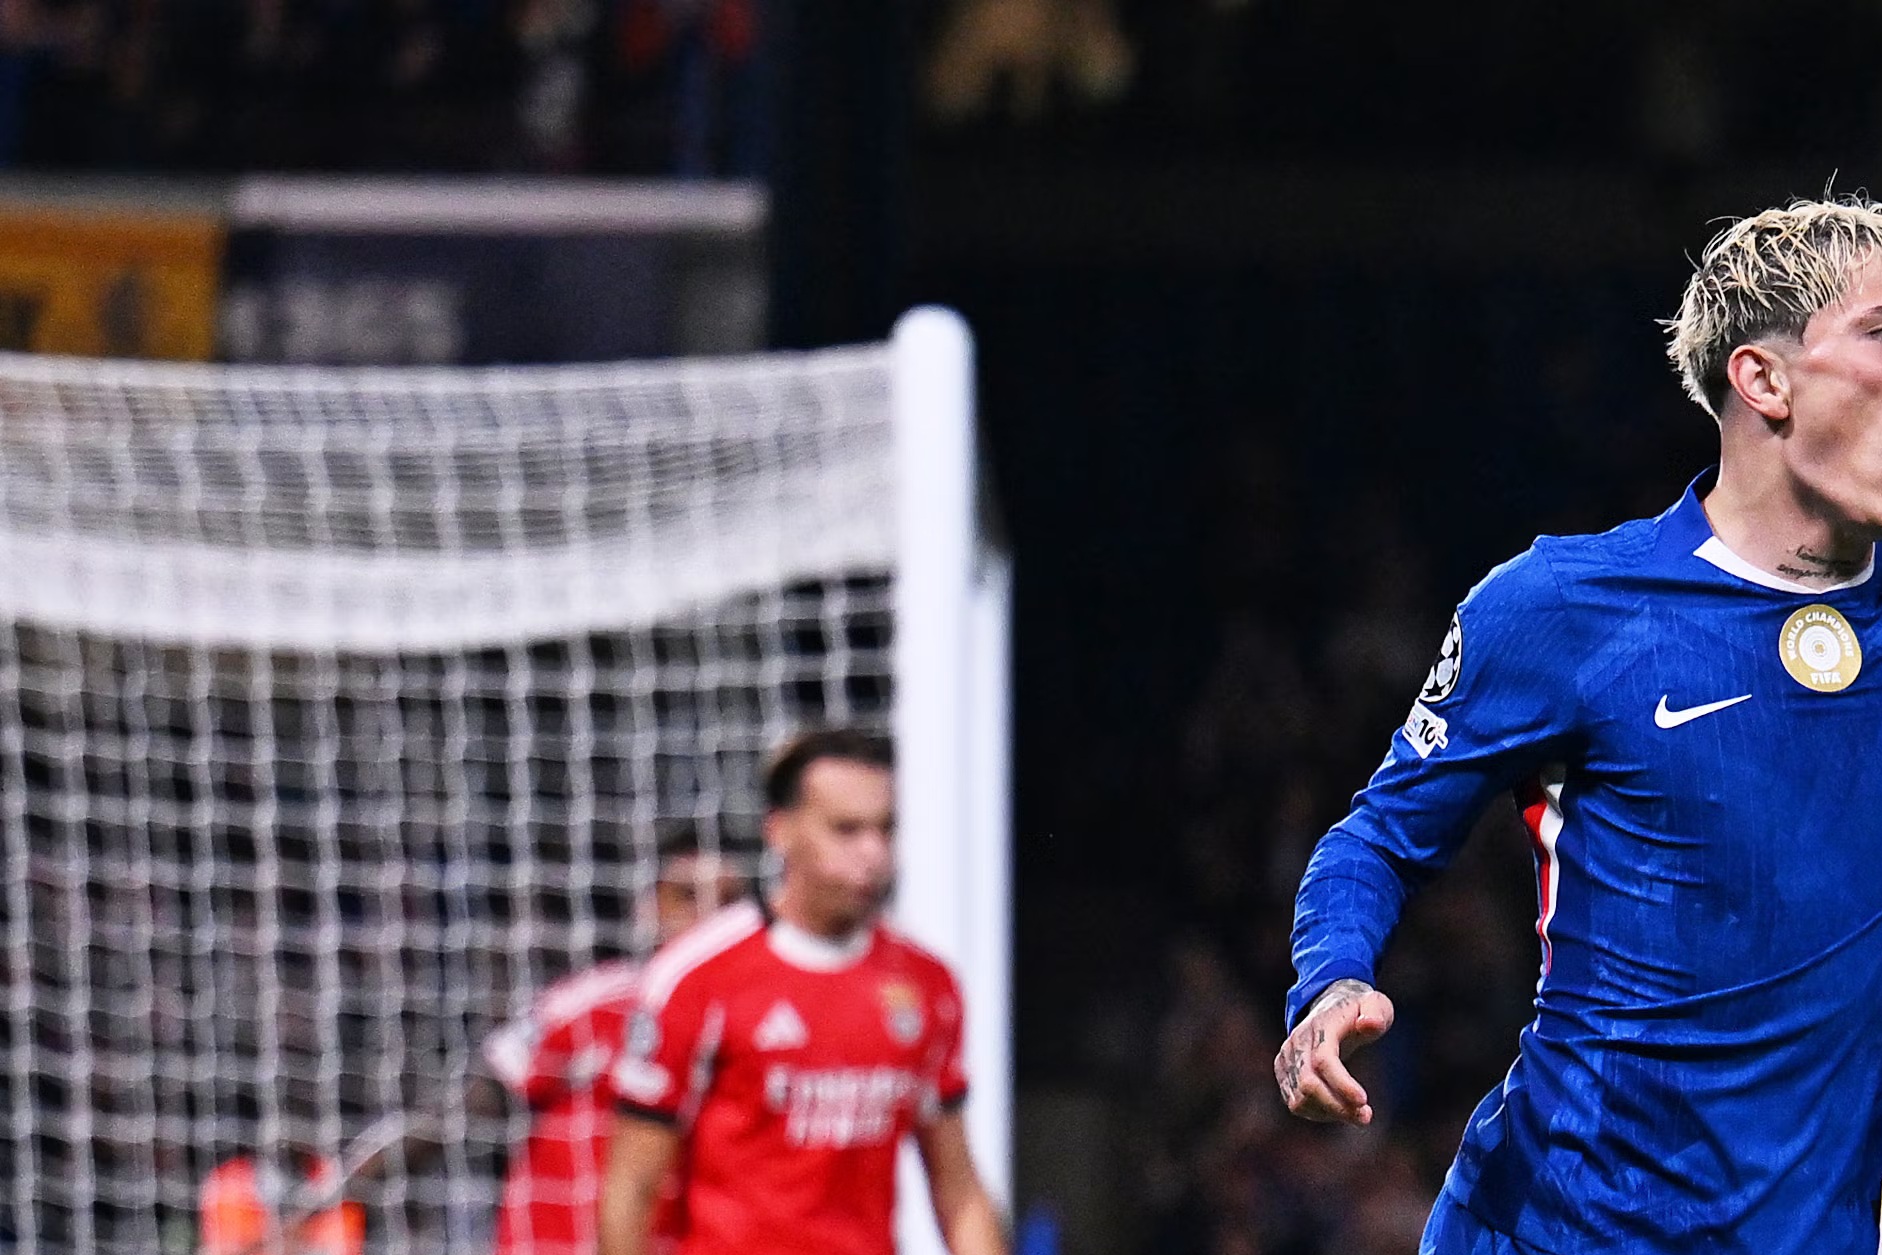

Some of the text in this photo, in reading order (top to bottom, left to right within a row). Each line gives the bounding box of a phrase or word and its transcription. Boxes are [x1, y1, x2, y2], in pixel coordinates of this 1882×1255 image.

[1786, 611, 1854, 660] WORLD CHAMPIONS
[1810, 672, 1842, 685] FIFA
